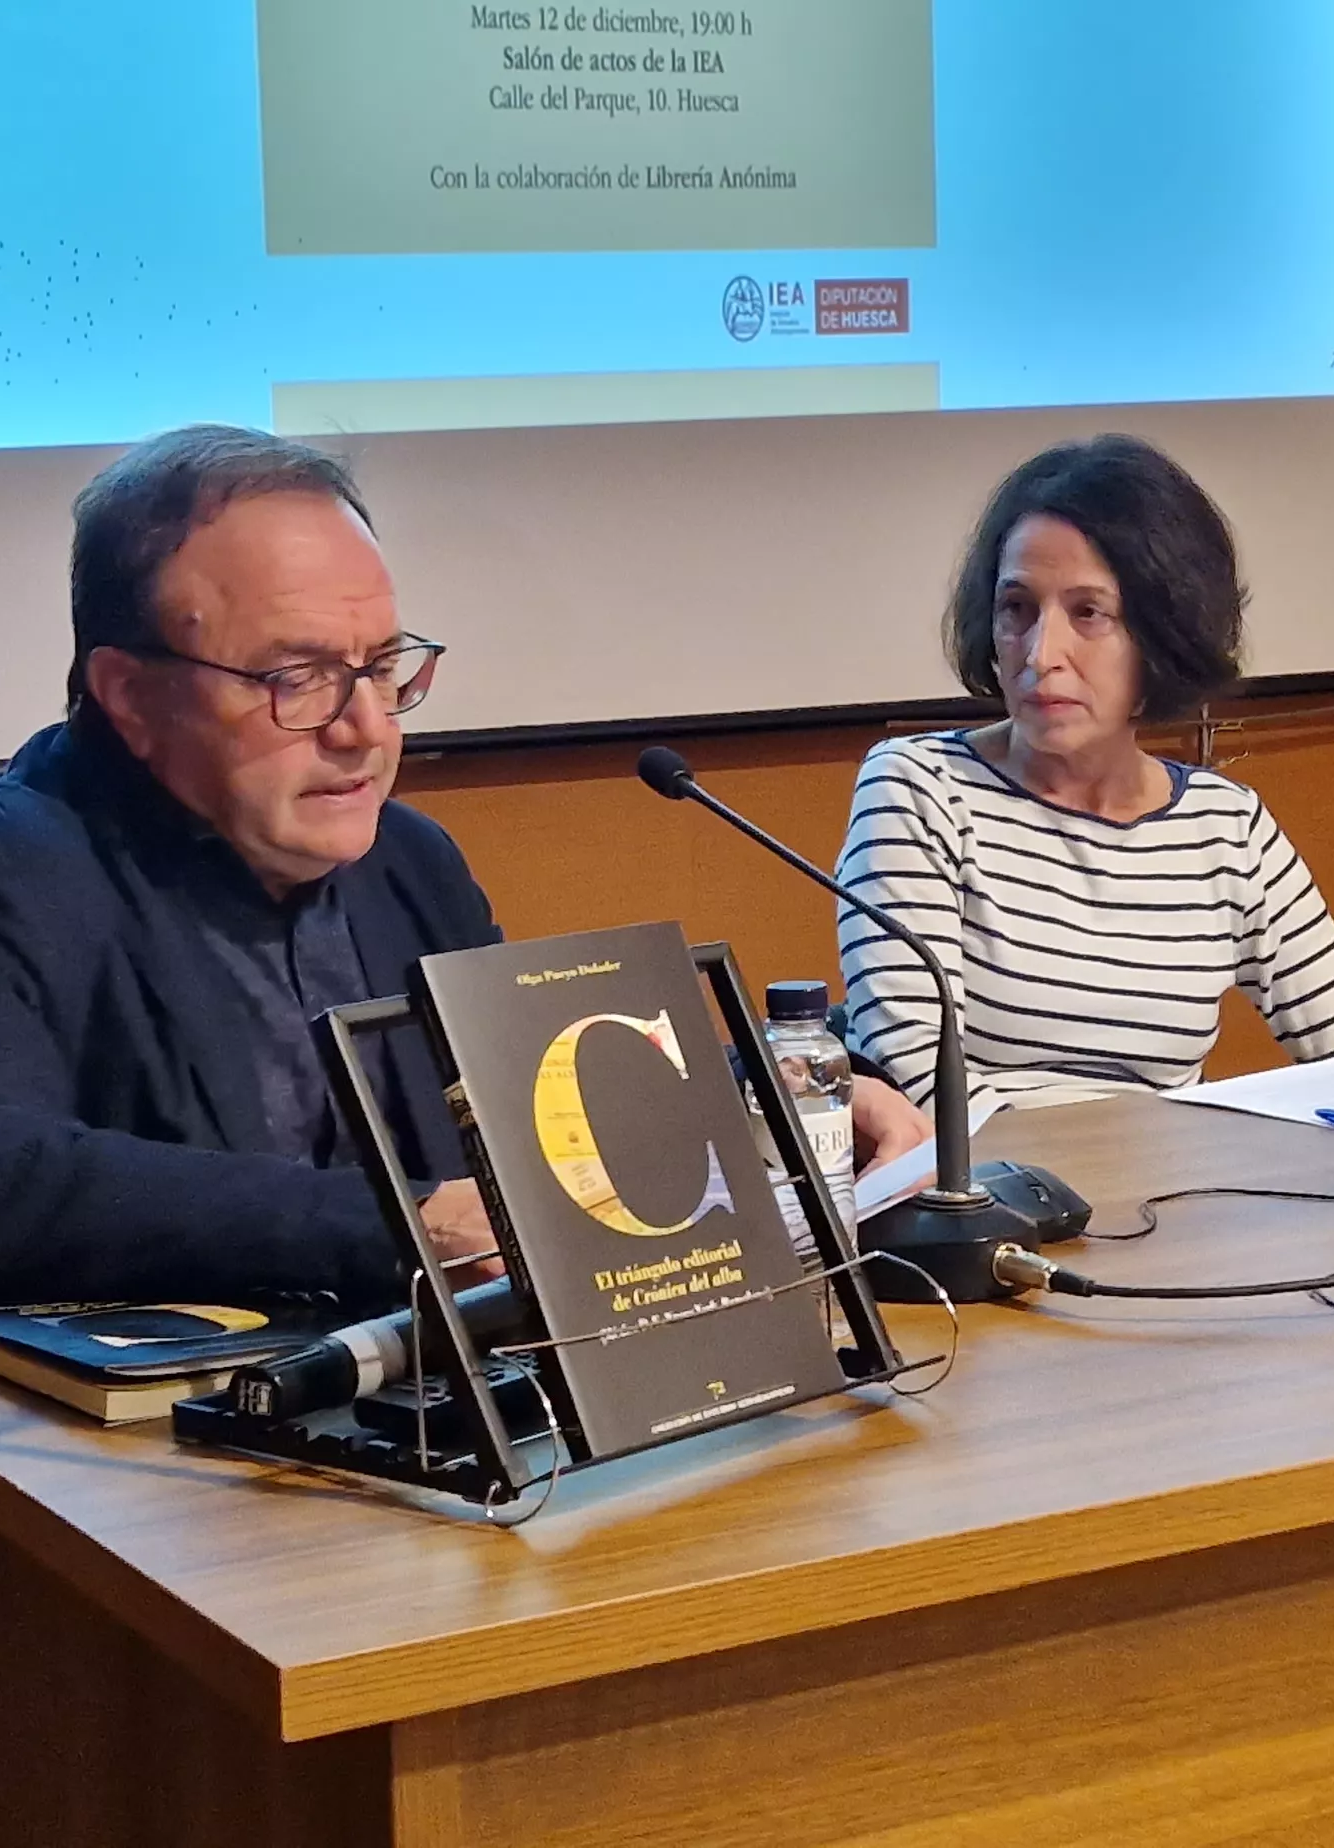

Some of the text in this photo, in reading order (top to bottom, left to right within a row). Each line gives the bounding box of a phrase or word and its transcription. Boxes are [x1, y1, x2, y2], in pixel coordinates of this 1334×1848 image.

[471, 5, 752, 38] Martes 12 de diciembre, 19:00 h
[503, 45, 725, 73] Salón de actos de la IEA
[489, 85, 739, 118] Calle del Parque, 10. Huesca
[430, 163, 797, 189] Con la colaboración de Librería Anónima
[769, 282, 805, 306] IEA
[821, 310, 898, 329] DE HUESCA
[595, 1238, 743, 1291] El triángulo editorial
[612, 1293, 632, 1312] de
[689, 1271, 711, 1293] del
[712, 1265, 743, 1288] alba
